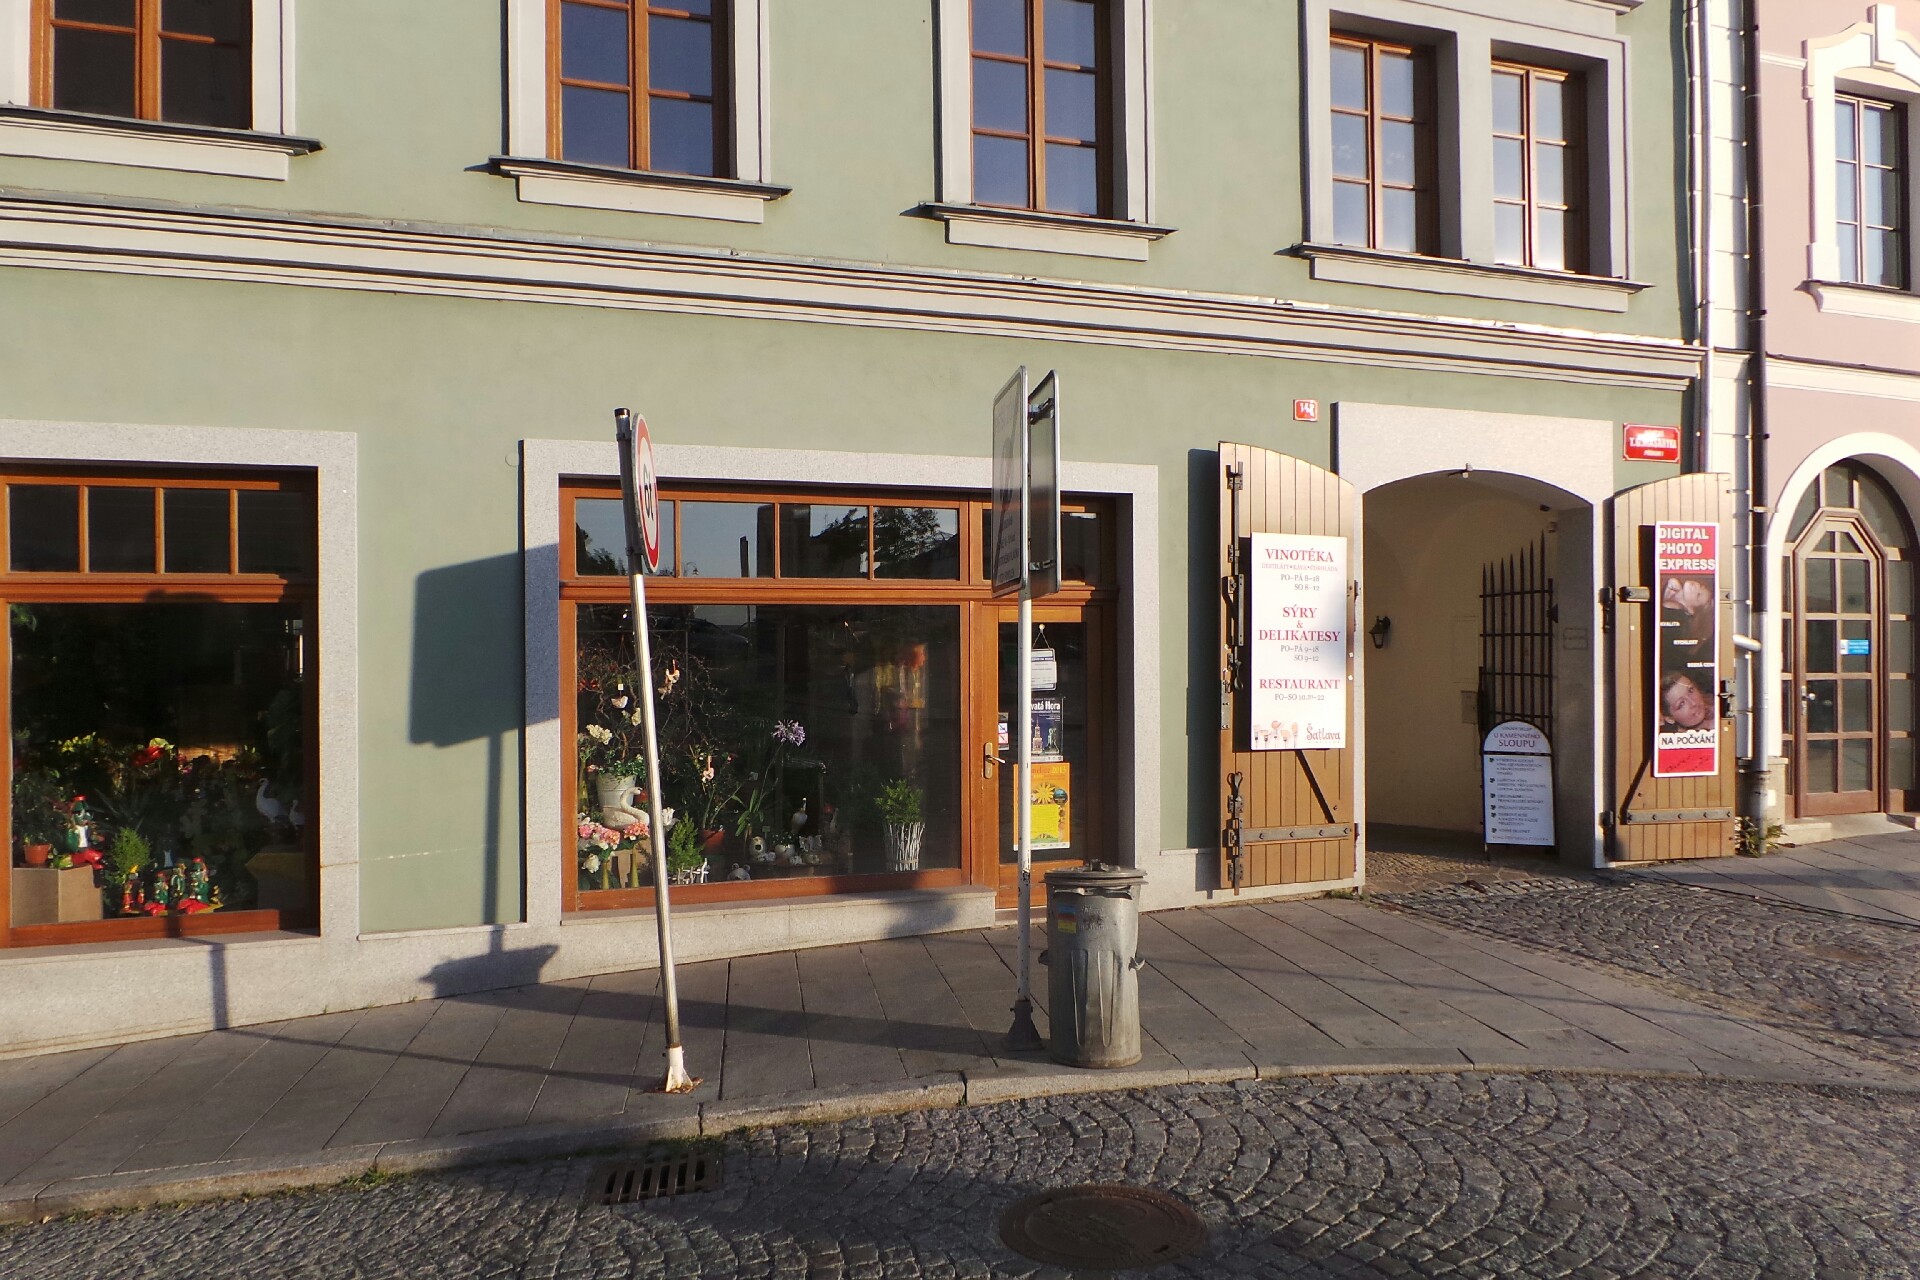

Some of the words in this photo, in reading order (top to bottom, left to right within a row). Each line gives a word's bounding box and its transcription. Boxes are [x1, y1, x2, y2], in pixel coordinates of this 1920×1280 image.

[1659, 527, 1709, 540] DIGITAL
[1659, 542, 1703, 555] PHOTO
[1265, 548, 1334, 562] VINOTÉKA
[1659, 558, 1715, 571] EXPRESS
[1282, 605, 1318, 618] SÝRY
[1296, 620, 1303, 628] &
[1258, 630, 1340, 642] DELIKATESY
[1259, 678, 1340, 690] RESTAURANT
[1031, 701, 1044, 710] vatá
[1045, 701, 1060, 710] Hora
[1306, 723, 1340, 741] Šatlava
[1498, 740, 1535, 748] SLOUPU
[1676, 734, 1715, 744] POČKÁNÍ
